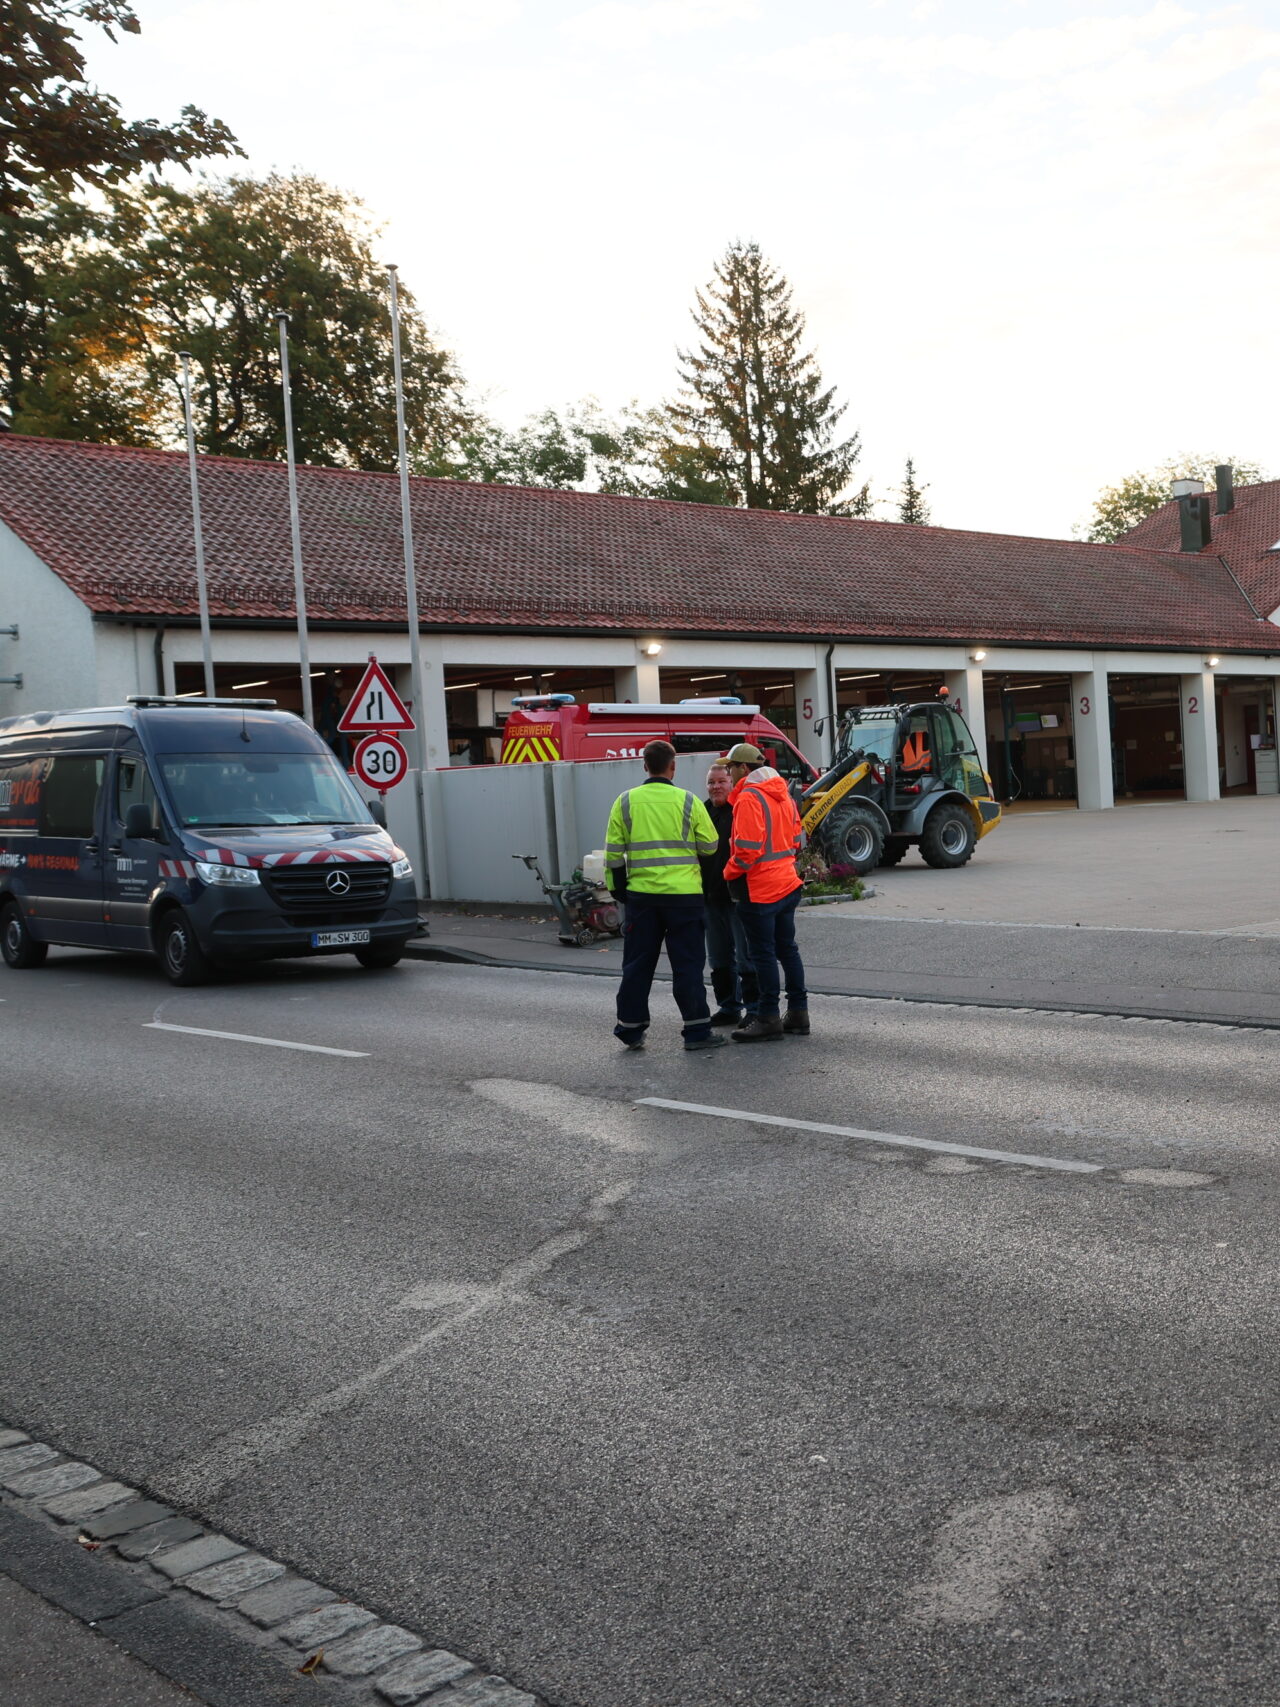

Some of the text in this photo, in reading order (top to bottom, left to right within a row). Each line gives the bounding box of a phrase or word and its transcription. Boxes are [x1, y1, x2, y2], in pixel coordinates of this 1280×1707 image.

[803, 698, 813, 720] 5
[1080, 697, 1091, 715] 3
[1188, 697, 1199, 714] 2
[508, 724, 552, 736] FEUERWEHR
[366, 749, 396, 775] 30
[317, 934, 332, 945] MM
[351, 931, 369, 942] 300
